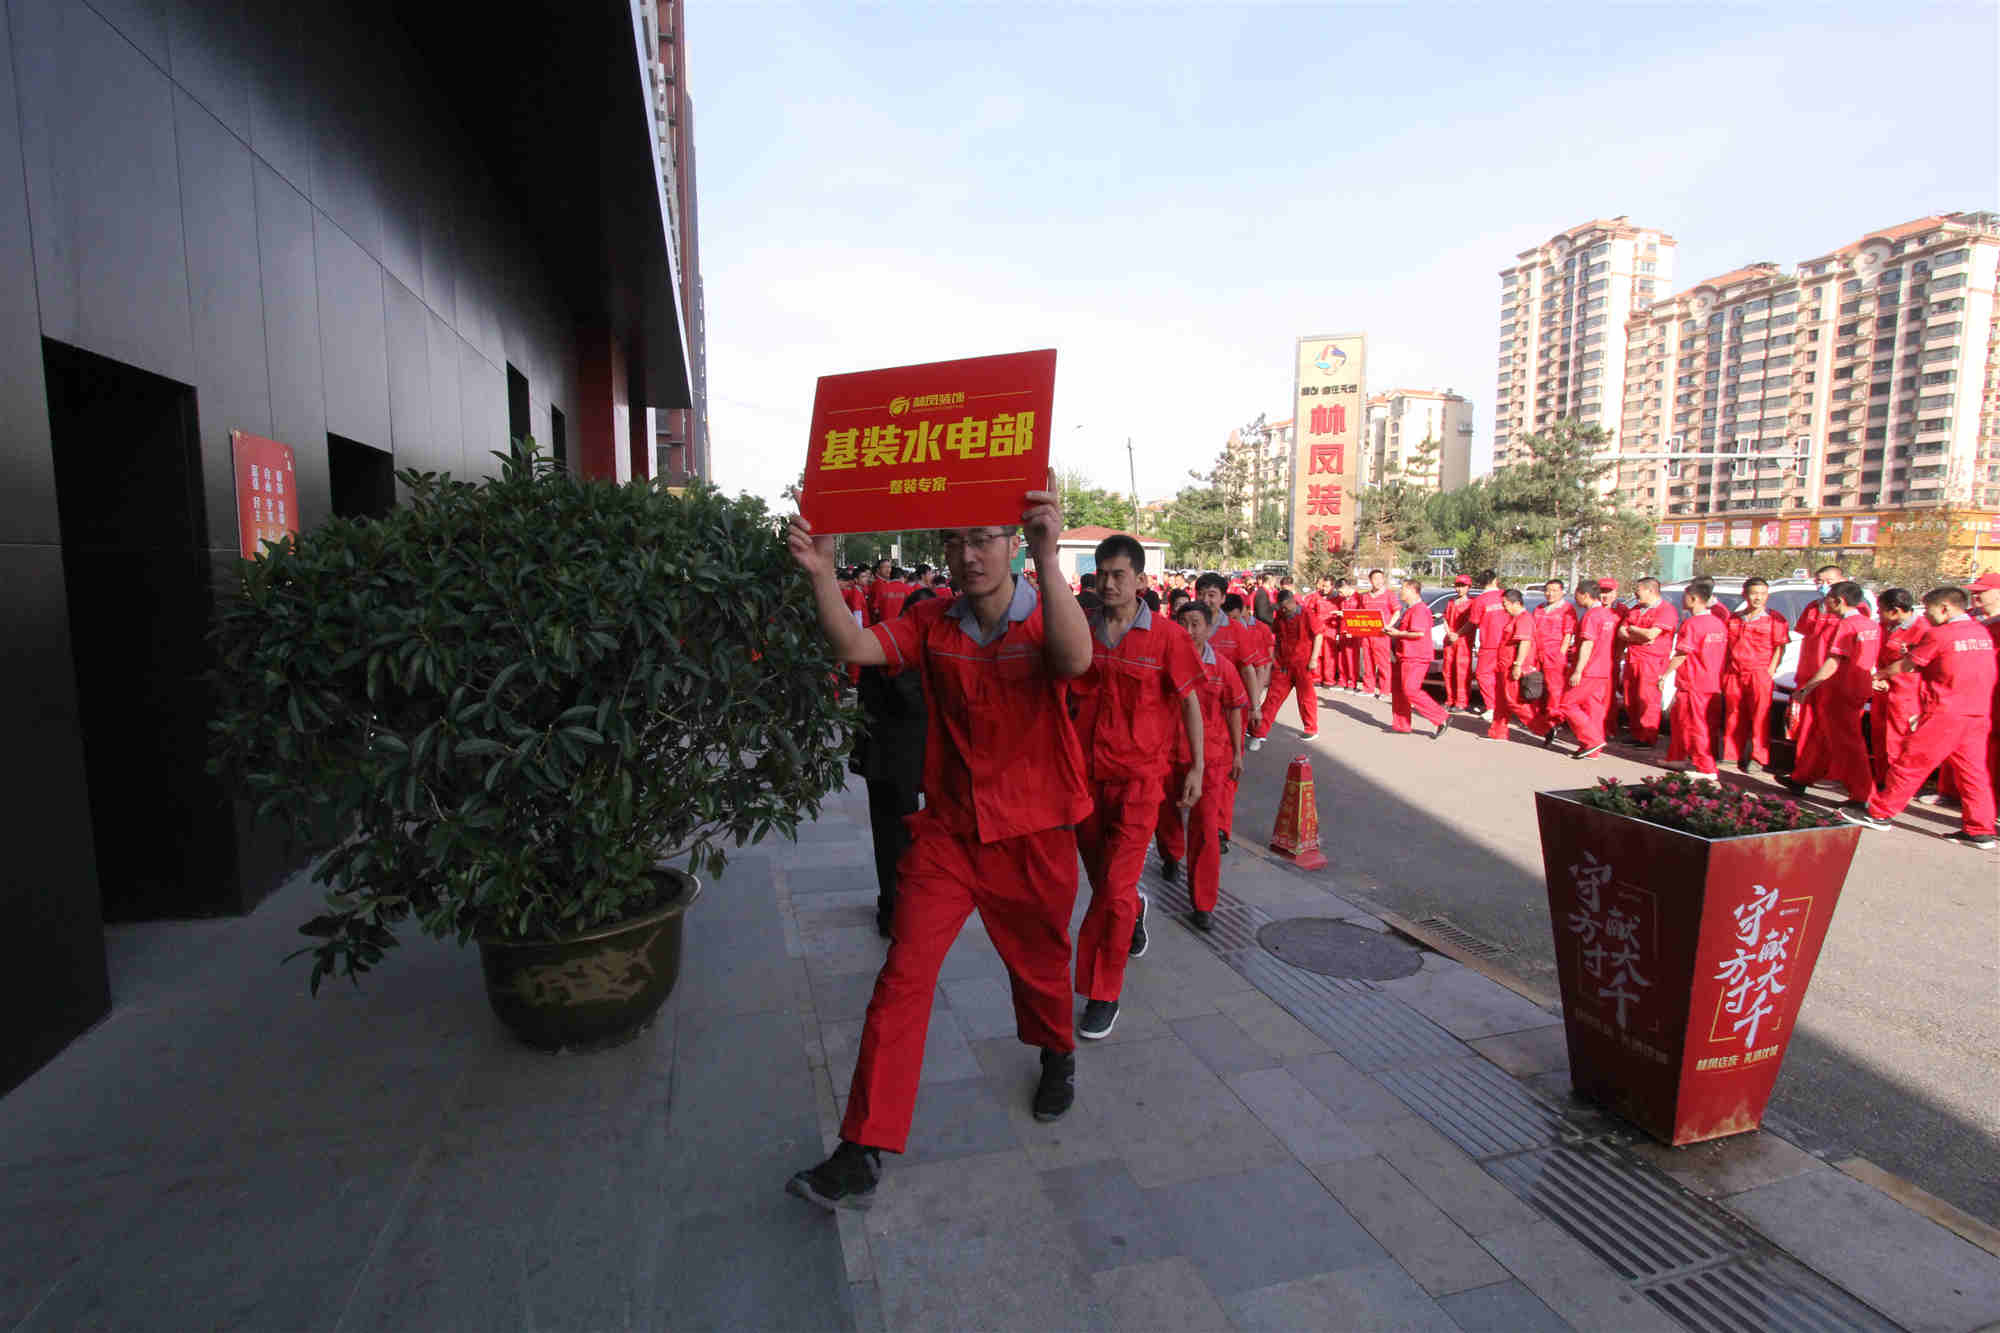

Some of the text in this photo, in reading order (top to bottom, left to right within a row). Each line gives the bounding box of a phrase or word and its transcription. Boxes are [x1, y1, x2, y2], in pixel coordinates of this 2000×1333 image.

[820, 411, 1035, 470] 基装水电部
[889, 477, 947, 494] 整装专家
[1713, 885, 1780, 1013] 守方寸
